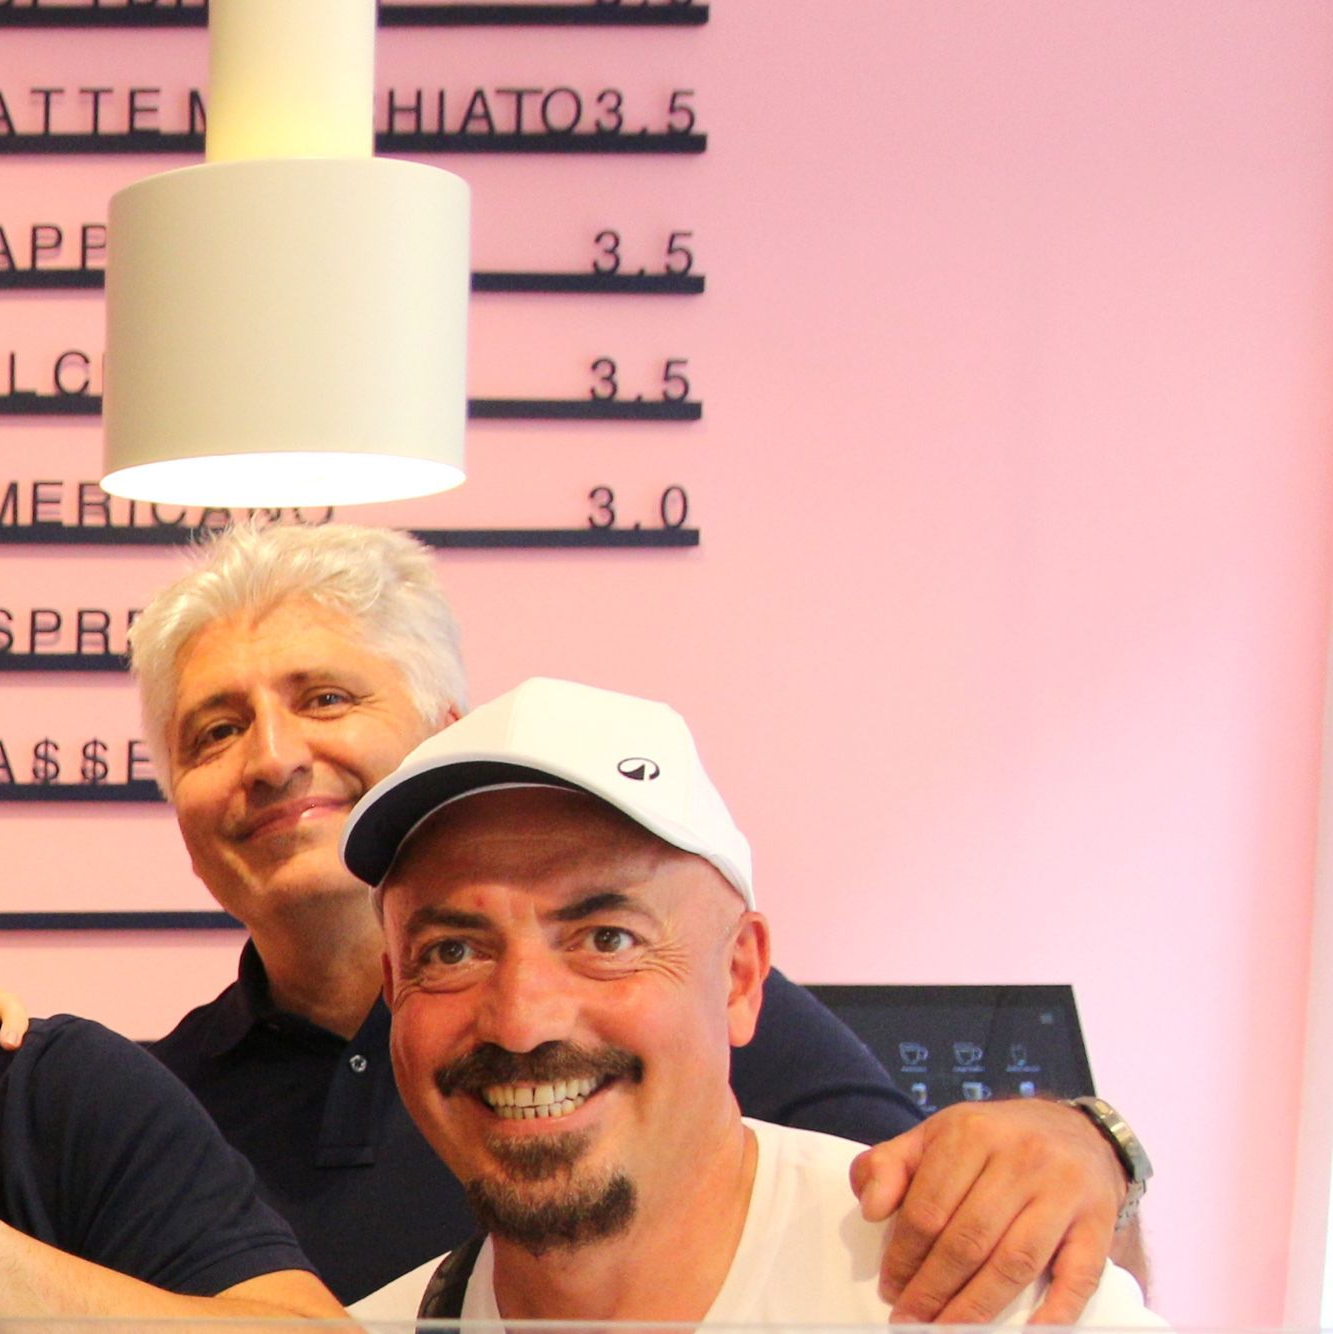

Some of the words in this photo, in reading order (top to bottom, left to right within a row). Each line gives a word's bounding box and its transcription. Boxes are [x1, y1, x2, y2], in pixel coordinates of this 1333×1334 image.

[593, 229, 693, 276] 3.5
[590, 358, 690, 403] 3.5
[588, 485, 688, 532] 3.0
